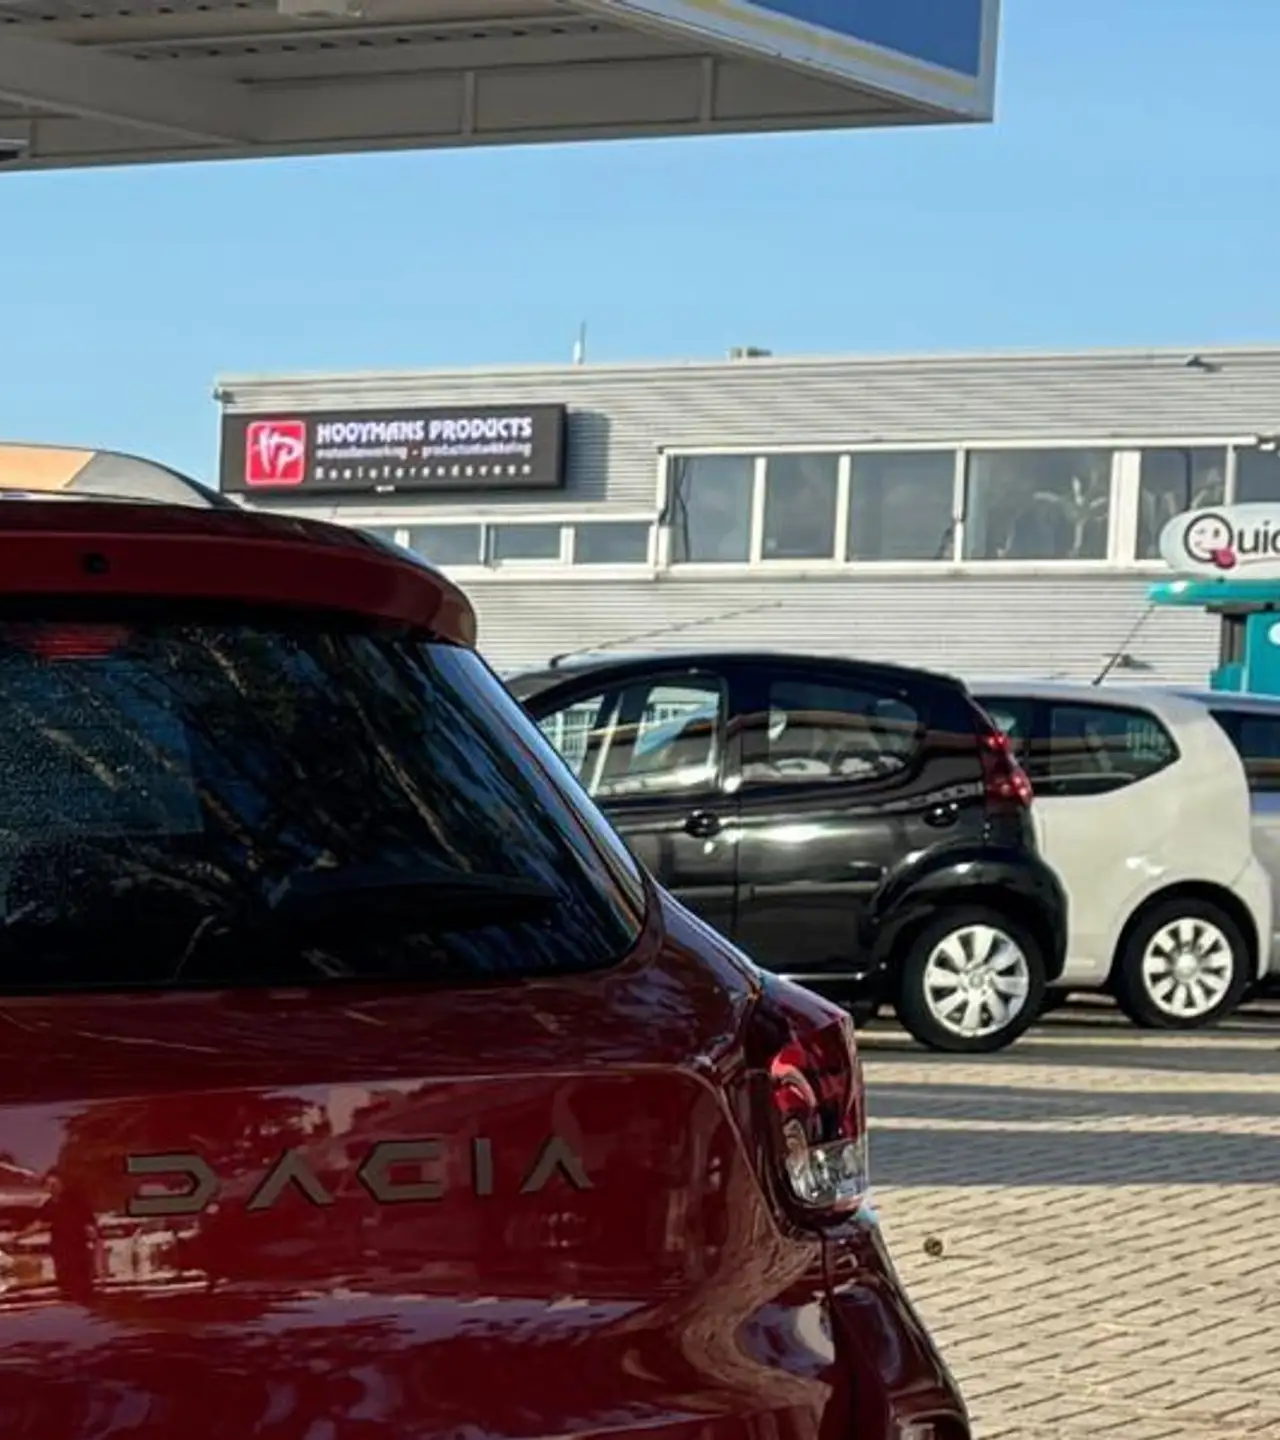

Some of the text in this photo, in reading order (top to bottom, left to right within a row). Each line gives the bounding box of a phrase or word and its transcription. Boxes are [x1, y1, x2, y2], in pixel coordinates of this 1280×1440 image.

[316, 416, 533, 445] HOOYMANS PRODUCTS
[127, 1134, 594, 1217] DACIA
